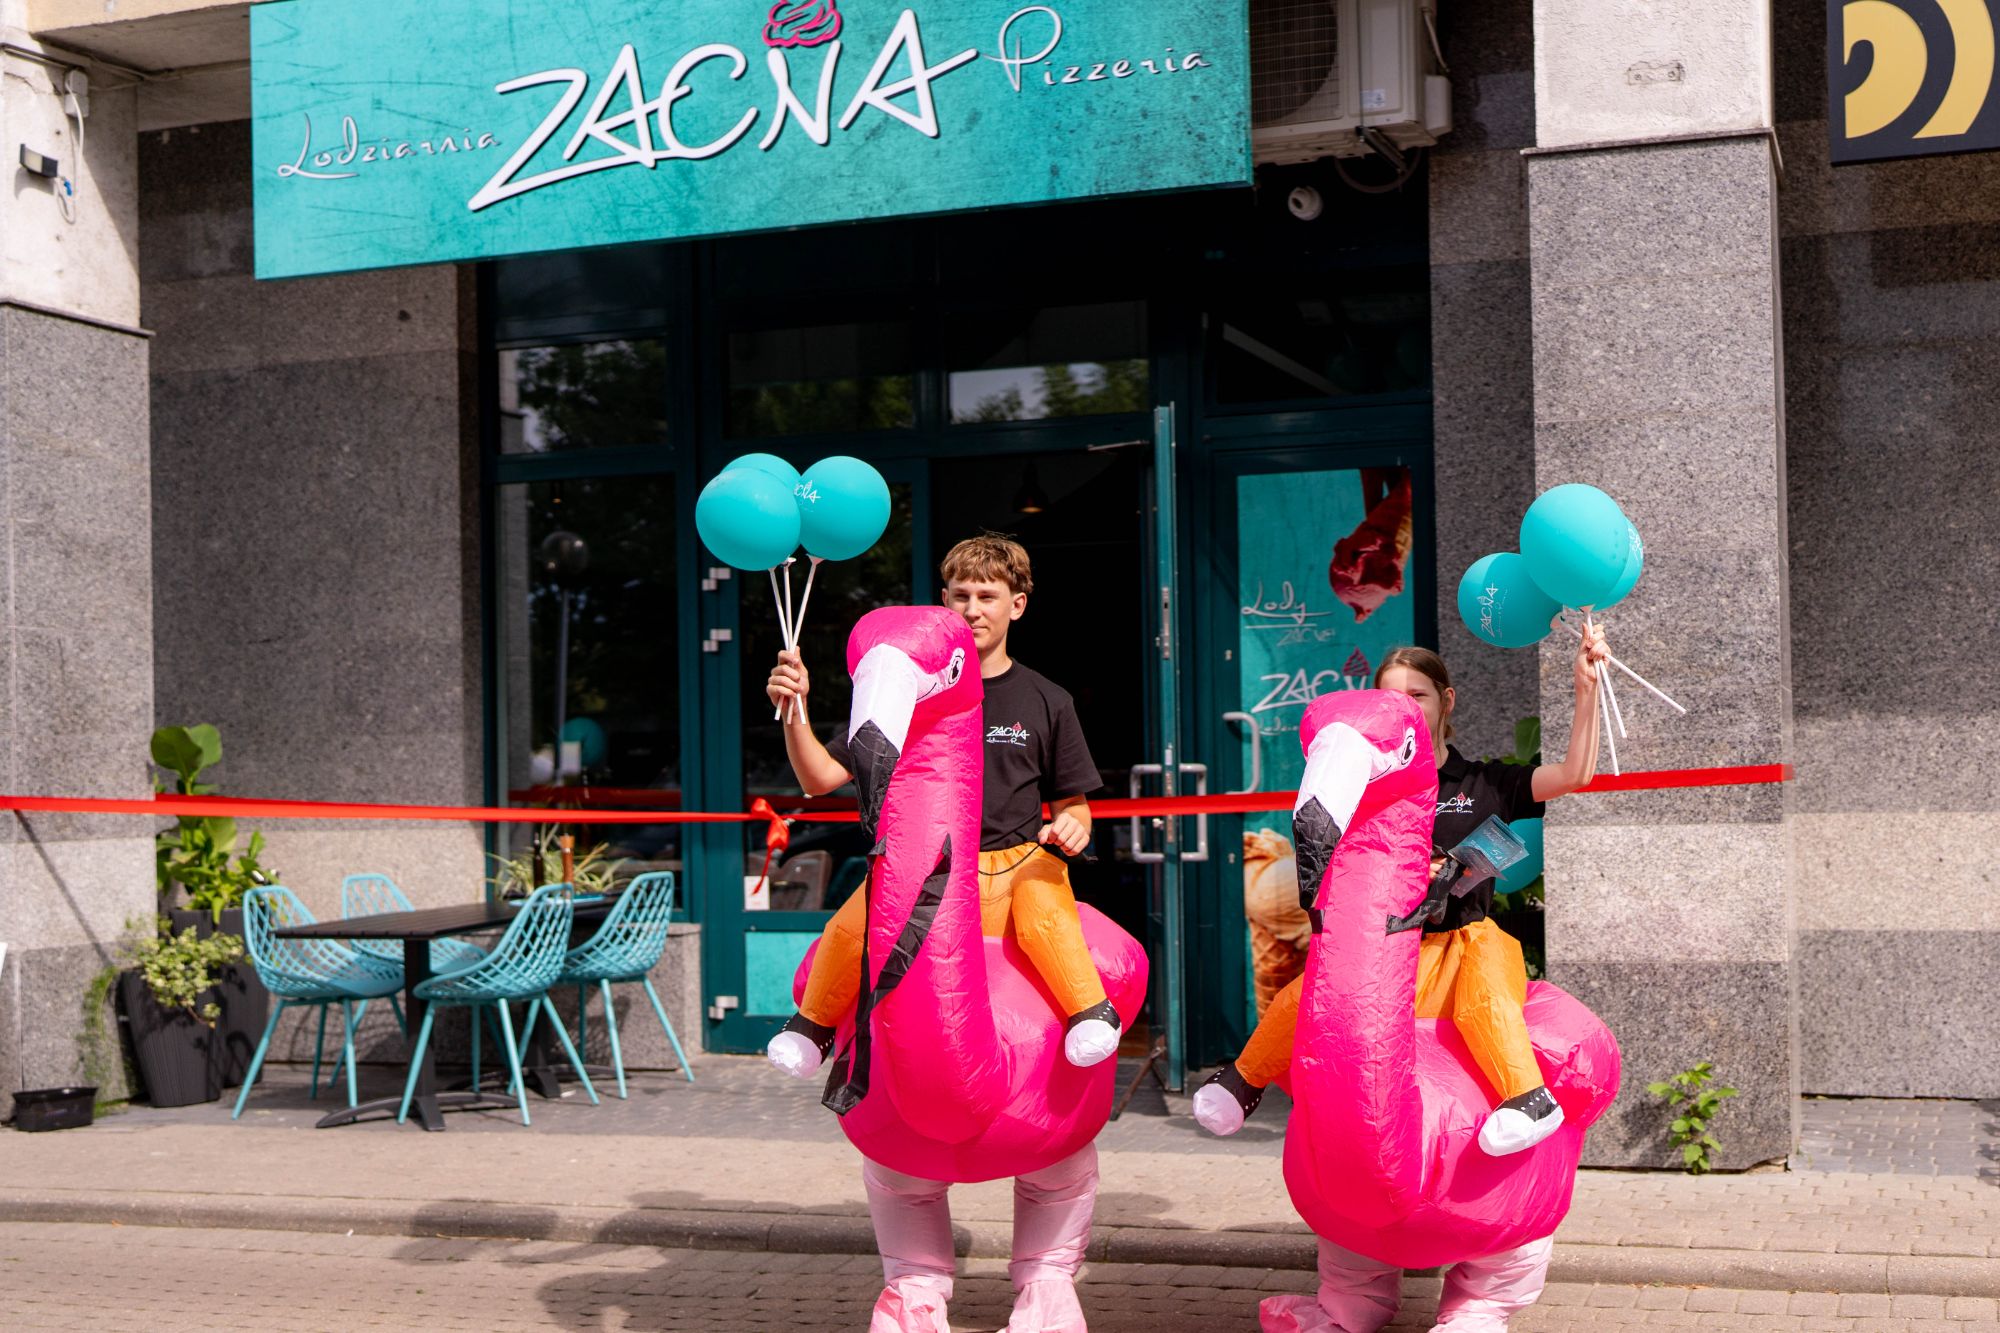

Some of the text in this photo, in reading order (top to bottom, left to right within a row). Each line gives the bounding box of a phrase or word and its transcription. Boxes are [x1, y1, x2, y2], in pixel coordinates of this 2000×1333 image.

[277, 5, 1212, 212] Lodziarnia ZACNA Pizzeria
[1241, 579, 1333, 625] Lody
[986, 725, 1030, 740] ZACNA
